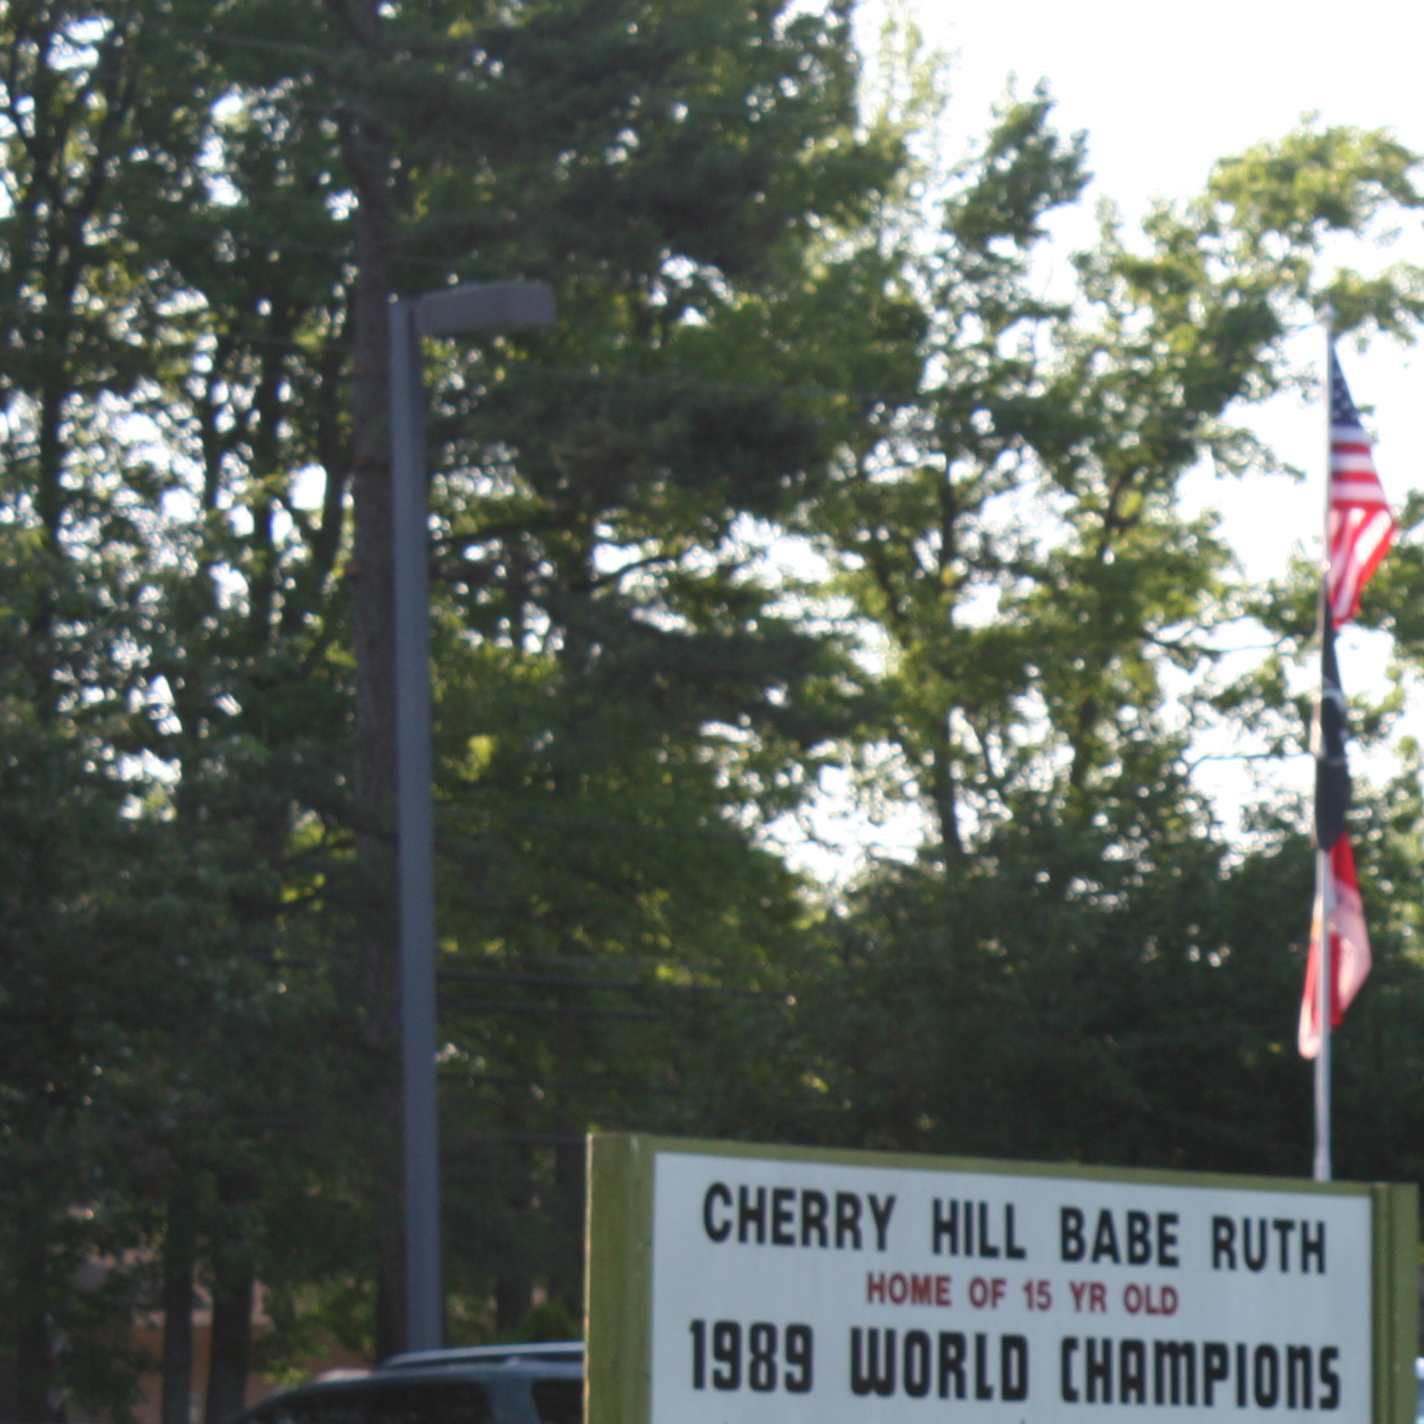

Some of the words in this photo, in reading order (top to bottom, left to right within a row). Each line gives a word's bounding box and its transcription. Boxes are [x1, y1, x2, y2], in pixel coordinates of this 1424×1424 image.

[703, 1181, 897, 1252] CHERRY
[931, 1197, 1027, 1261] HILL
[1060, 1206, 1181, 1268] BABE
[1211, 1215, 1328, 1276] RUTH
[865, 1272, 953, 1308] HOME
[967, 1277, 1008, 1310] OF
[1023, 1281, 1052, 1312] 15
[1069, 1281, 1108, 1314] YR
[1123, 1283, 1180, 1317] OLD
[690, 1318, 814, 1394] 1989
[850, 1326, 1030, 1403] WORLD
[1060, 1335, 1341, 1412] CHAMPIONS
